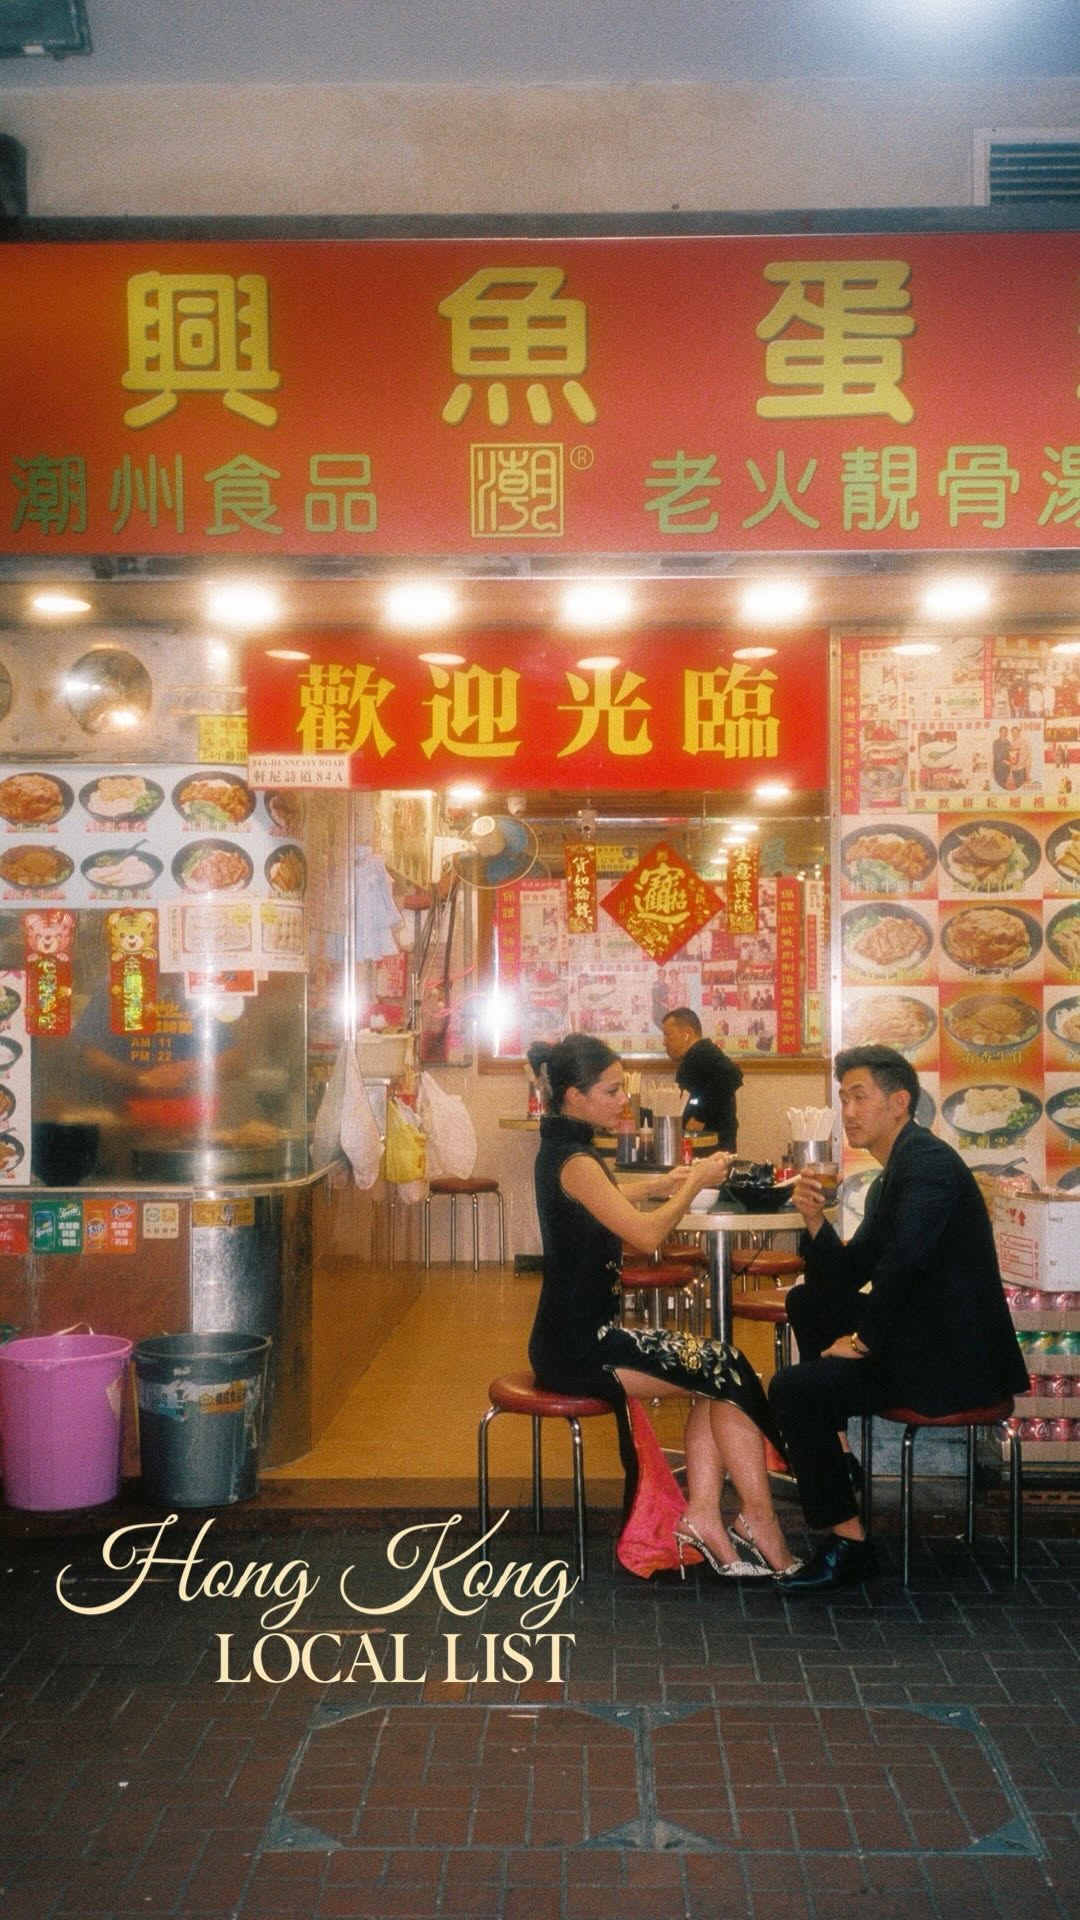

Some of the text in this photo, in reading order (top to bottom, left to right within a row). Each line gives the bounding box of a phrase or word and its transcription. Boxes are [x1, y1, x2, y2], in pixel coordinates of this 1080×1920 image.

[121, 258, 1080, 428] 興魚蛋
[10, 453, 378, 537] 潮州食品
[643, 444, 1080, 536] 老火靚骨湯
[296, 663, 780, 759] 歡迎光臨
[131, 1038, 150, 1048] AM
[131, 1051, 150, 1062] PM
